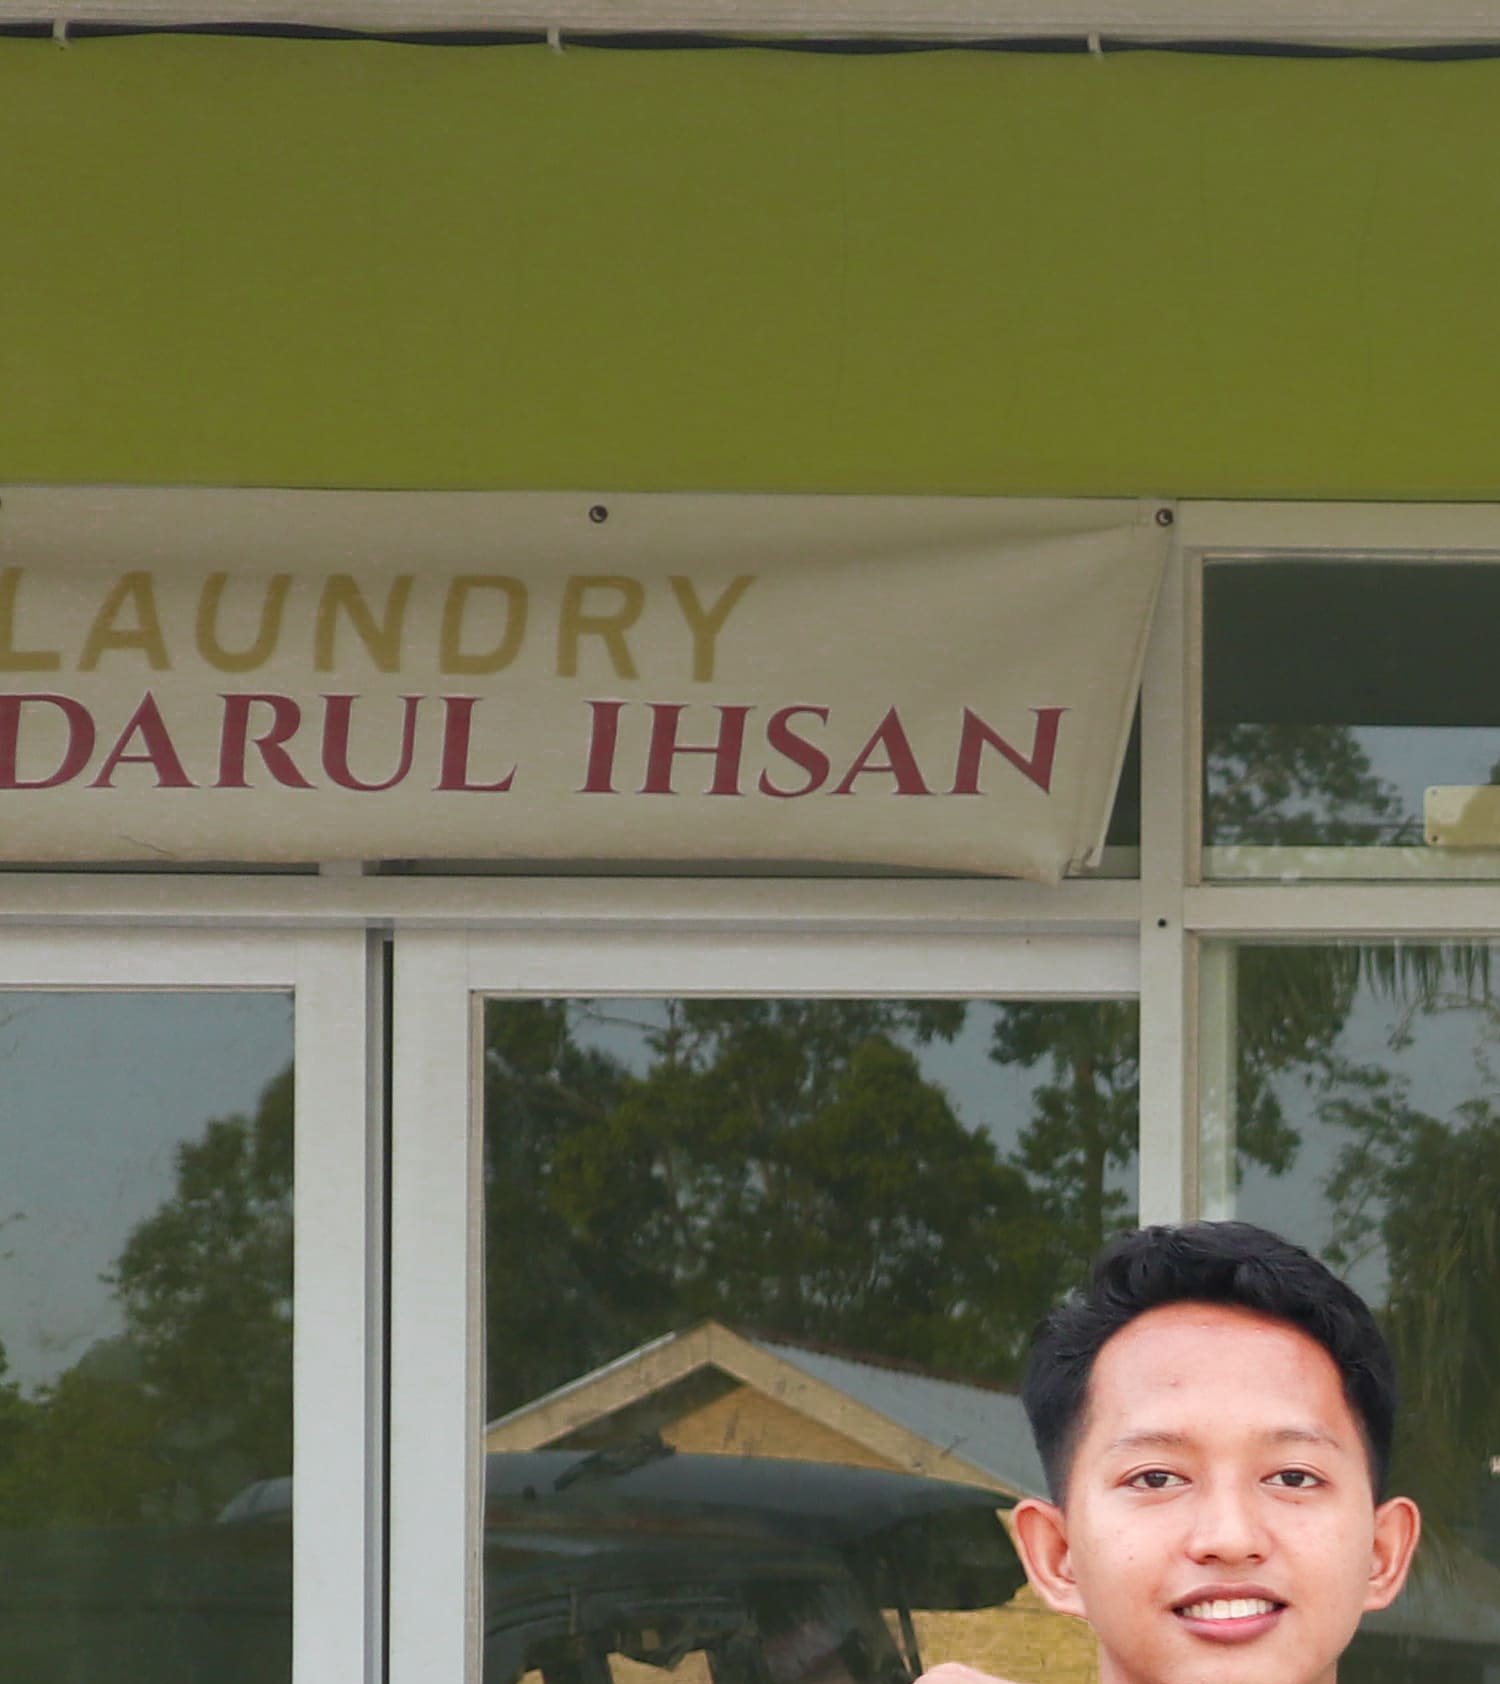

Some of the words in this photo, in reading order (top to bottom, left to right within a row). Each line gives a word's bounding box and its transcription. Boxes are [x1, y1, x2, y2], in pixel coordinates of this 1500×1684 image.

[0, 567, 754, 682] LAUNDRY
[0, 691, 517, 792] DARUL
[576, 699, 1071, 798] IHSAN
